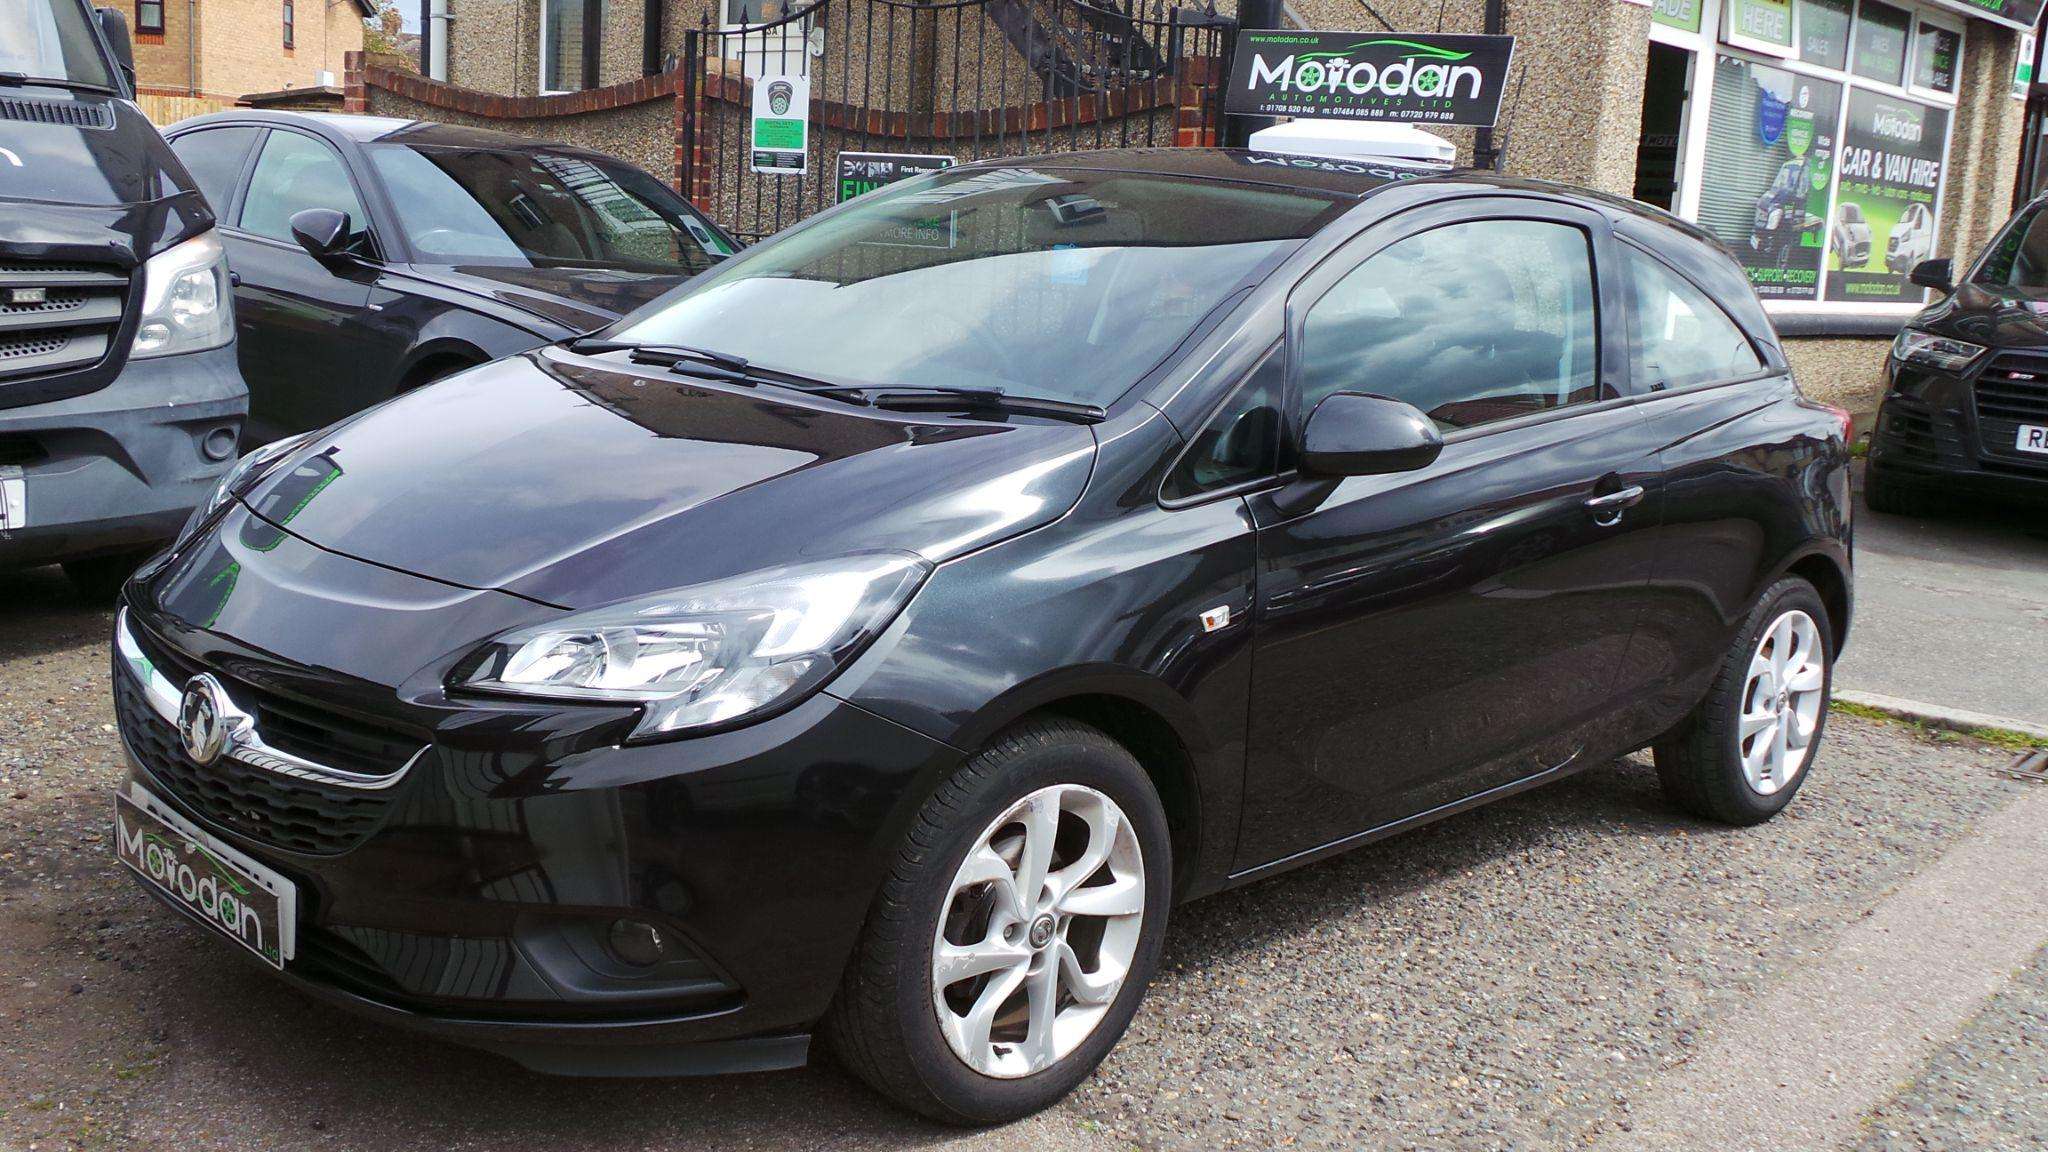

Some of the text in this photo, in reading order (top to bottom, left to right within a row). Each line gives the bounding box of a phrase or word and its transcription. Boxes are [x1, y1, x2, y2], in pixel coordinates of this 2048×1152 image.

[1250, 36, 1319, 44] www.motodan.co.uk
[1742, 5, 1784, 39] HERE
[1247, 53, 1482, 99] Motodan
[1269, 93, 1453, 108] AUTOMOTIVES LTD
[1841, 145, 1940, 188] CAR & VAN HIRE
[118, 814, 263, 950] Motodan
